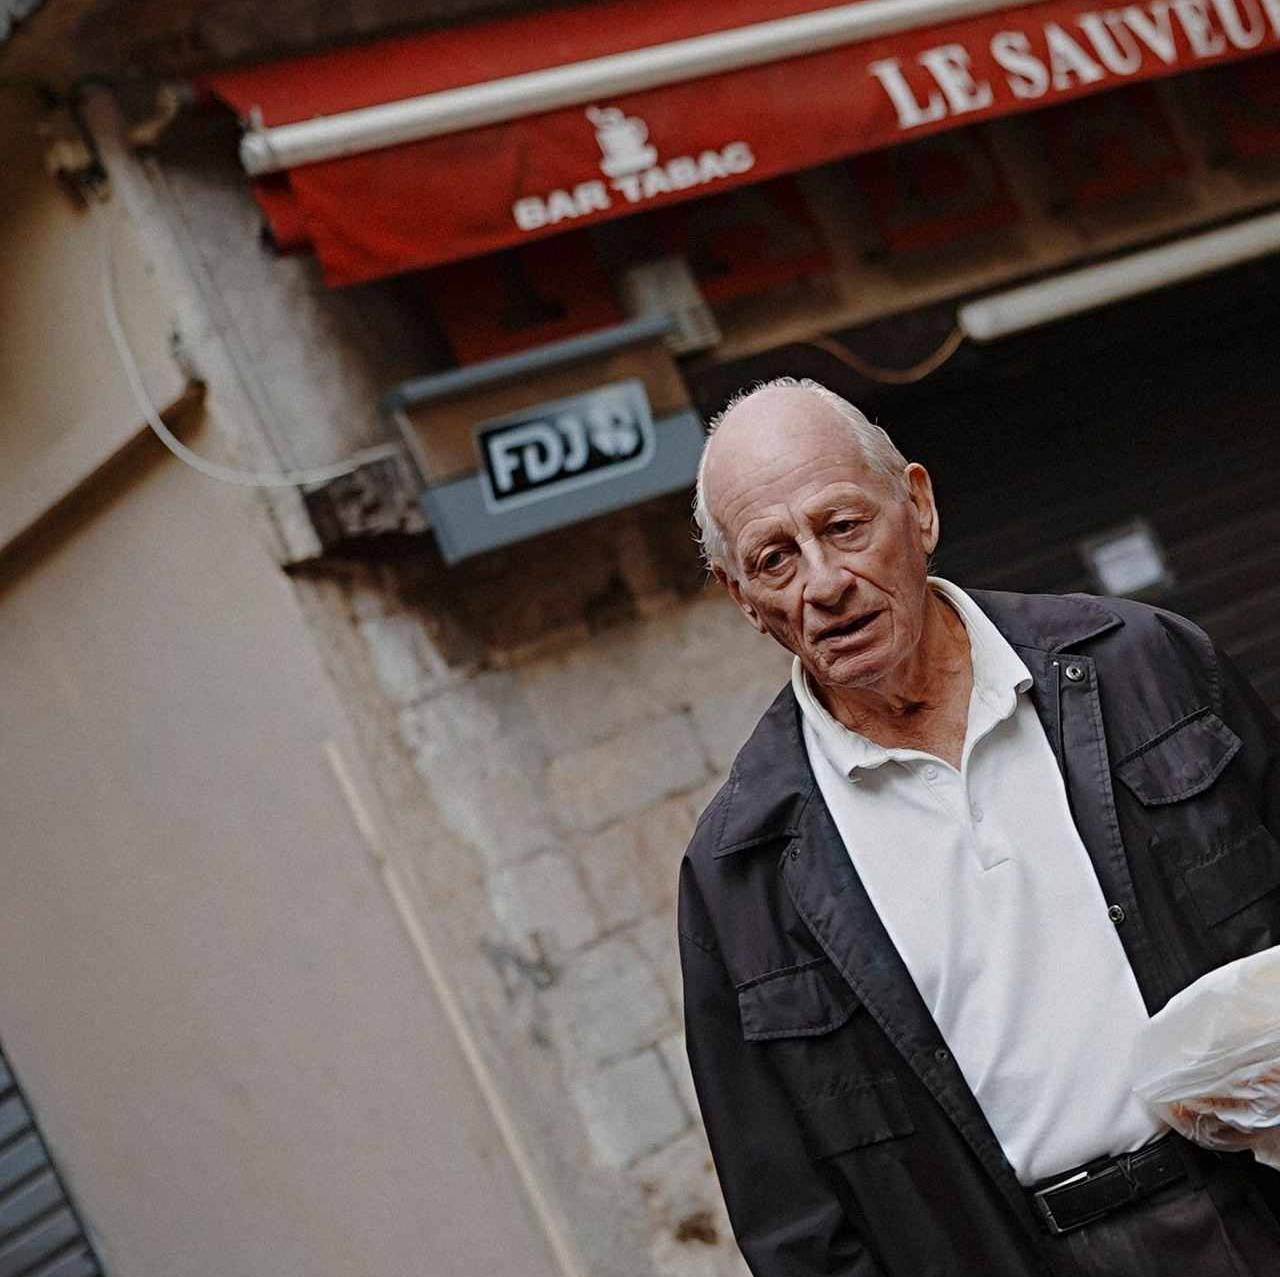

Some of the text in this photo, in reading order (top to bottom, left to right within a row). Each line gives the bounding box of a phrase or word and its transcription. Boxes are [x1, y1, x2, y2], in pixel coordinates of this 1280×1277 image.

[868, 41, 995, 131] LE
[513, 141, 755, 231] BAR TABAC
[488, 412, 590, 492] FDJ
